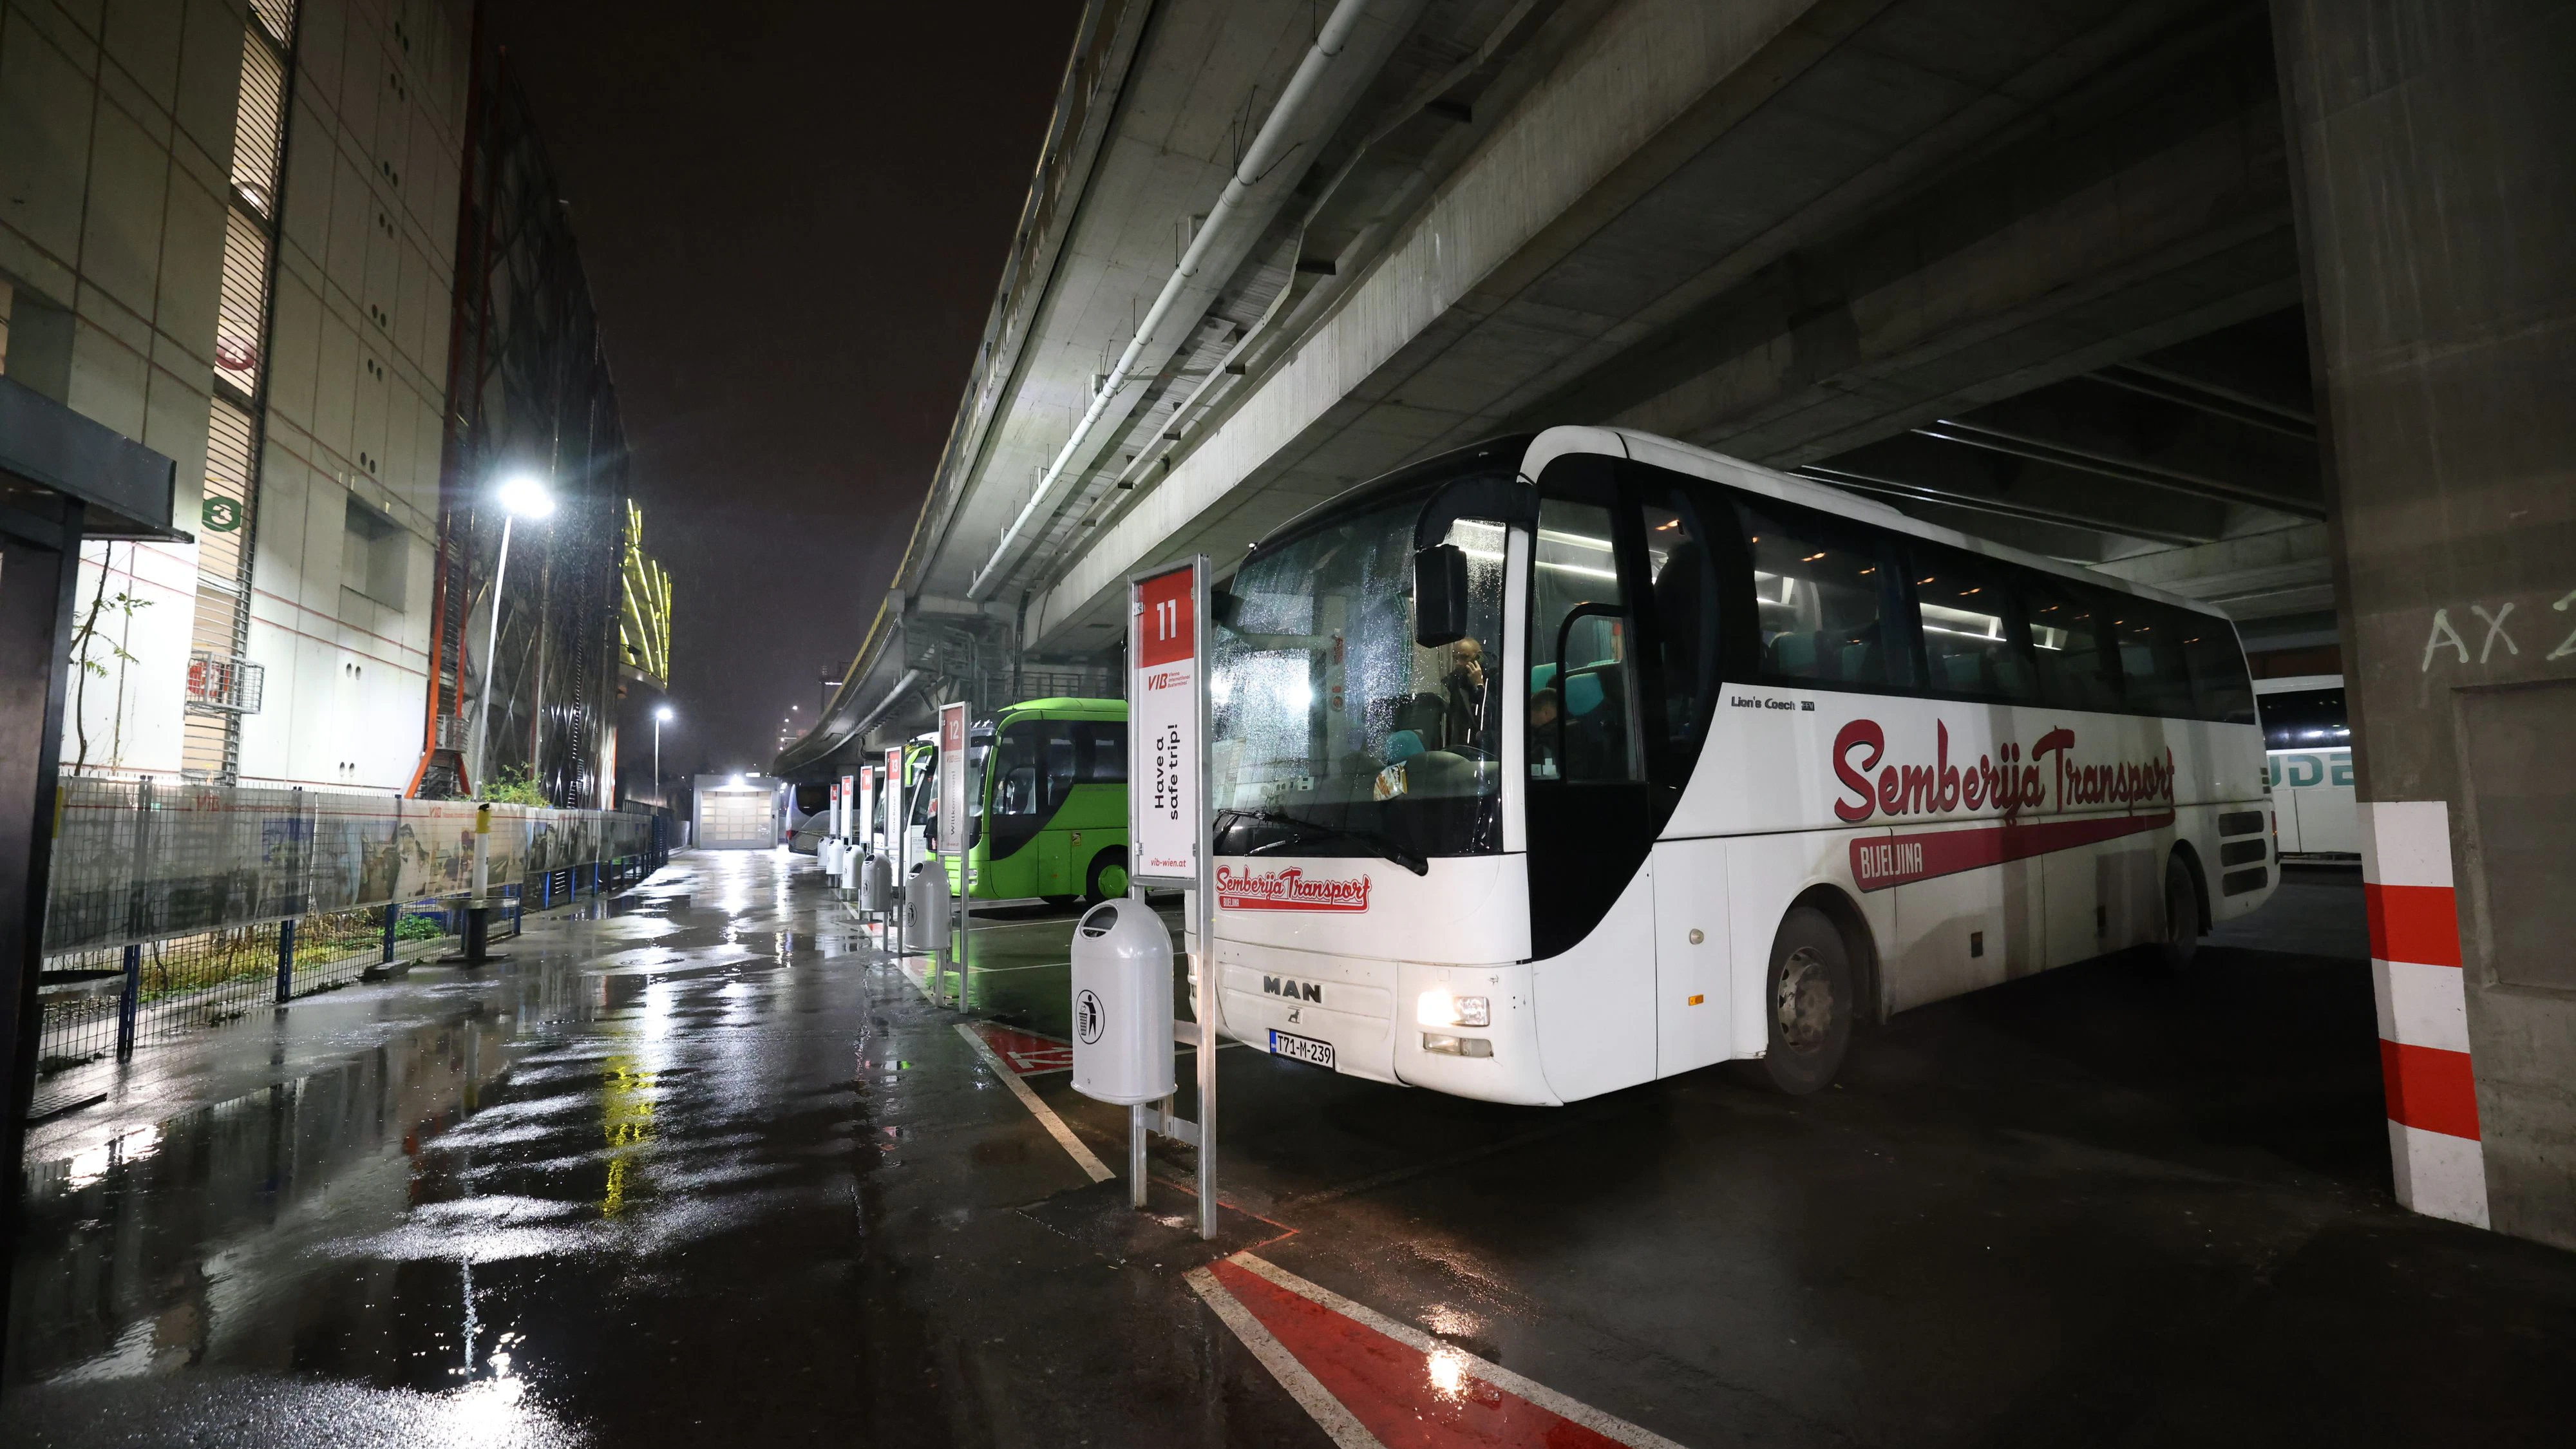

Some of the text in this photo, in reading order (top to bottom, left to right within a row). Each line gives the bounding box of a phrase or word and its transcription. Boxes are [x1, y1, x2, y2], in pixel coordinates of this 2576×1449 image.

[224, 345, 247, 364] 4
[211, 504, 232, 525] 3
[1157, 599, 1176, 641] 11
[2422, 602, 2518, 672] AX
[1148, 673, 1168, 691] VIB
[1731, 696, 1761, 708] Lion's
[1765, 698, 1795, 710] Coach
[949, 720, 959, 740] 12
[891, 759, 898, 773] 13
[1155, 737, 1164, 809] Have a
[1168, 724, 1180, 820] safe trip!
[1833, 718, 2175, 826] Semberija Transport
[1151, 858, 1186, 867] vib-wien.at
[1860, 842, 1923, 879] BIJELJINA
[1216, 865, 1372, 905] Semberija Transport
[1264, 975, 1322, 1004] MAN
[1277, 1034, 1331, 1065] T71-M-239
